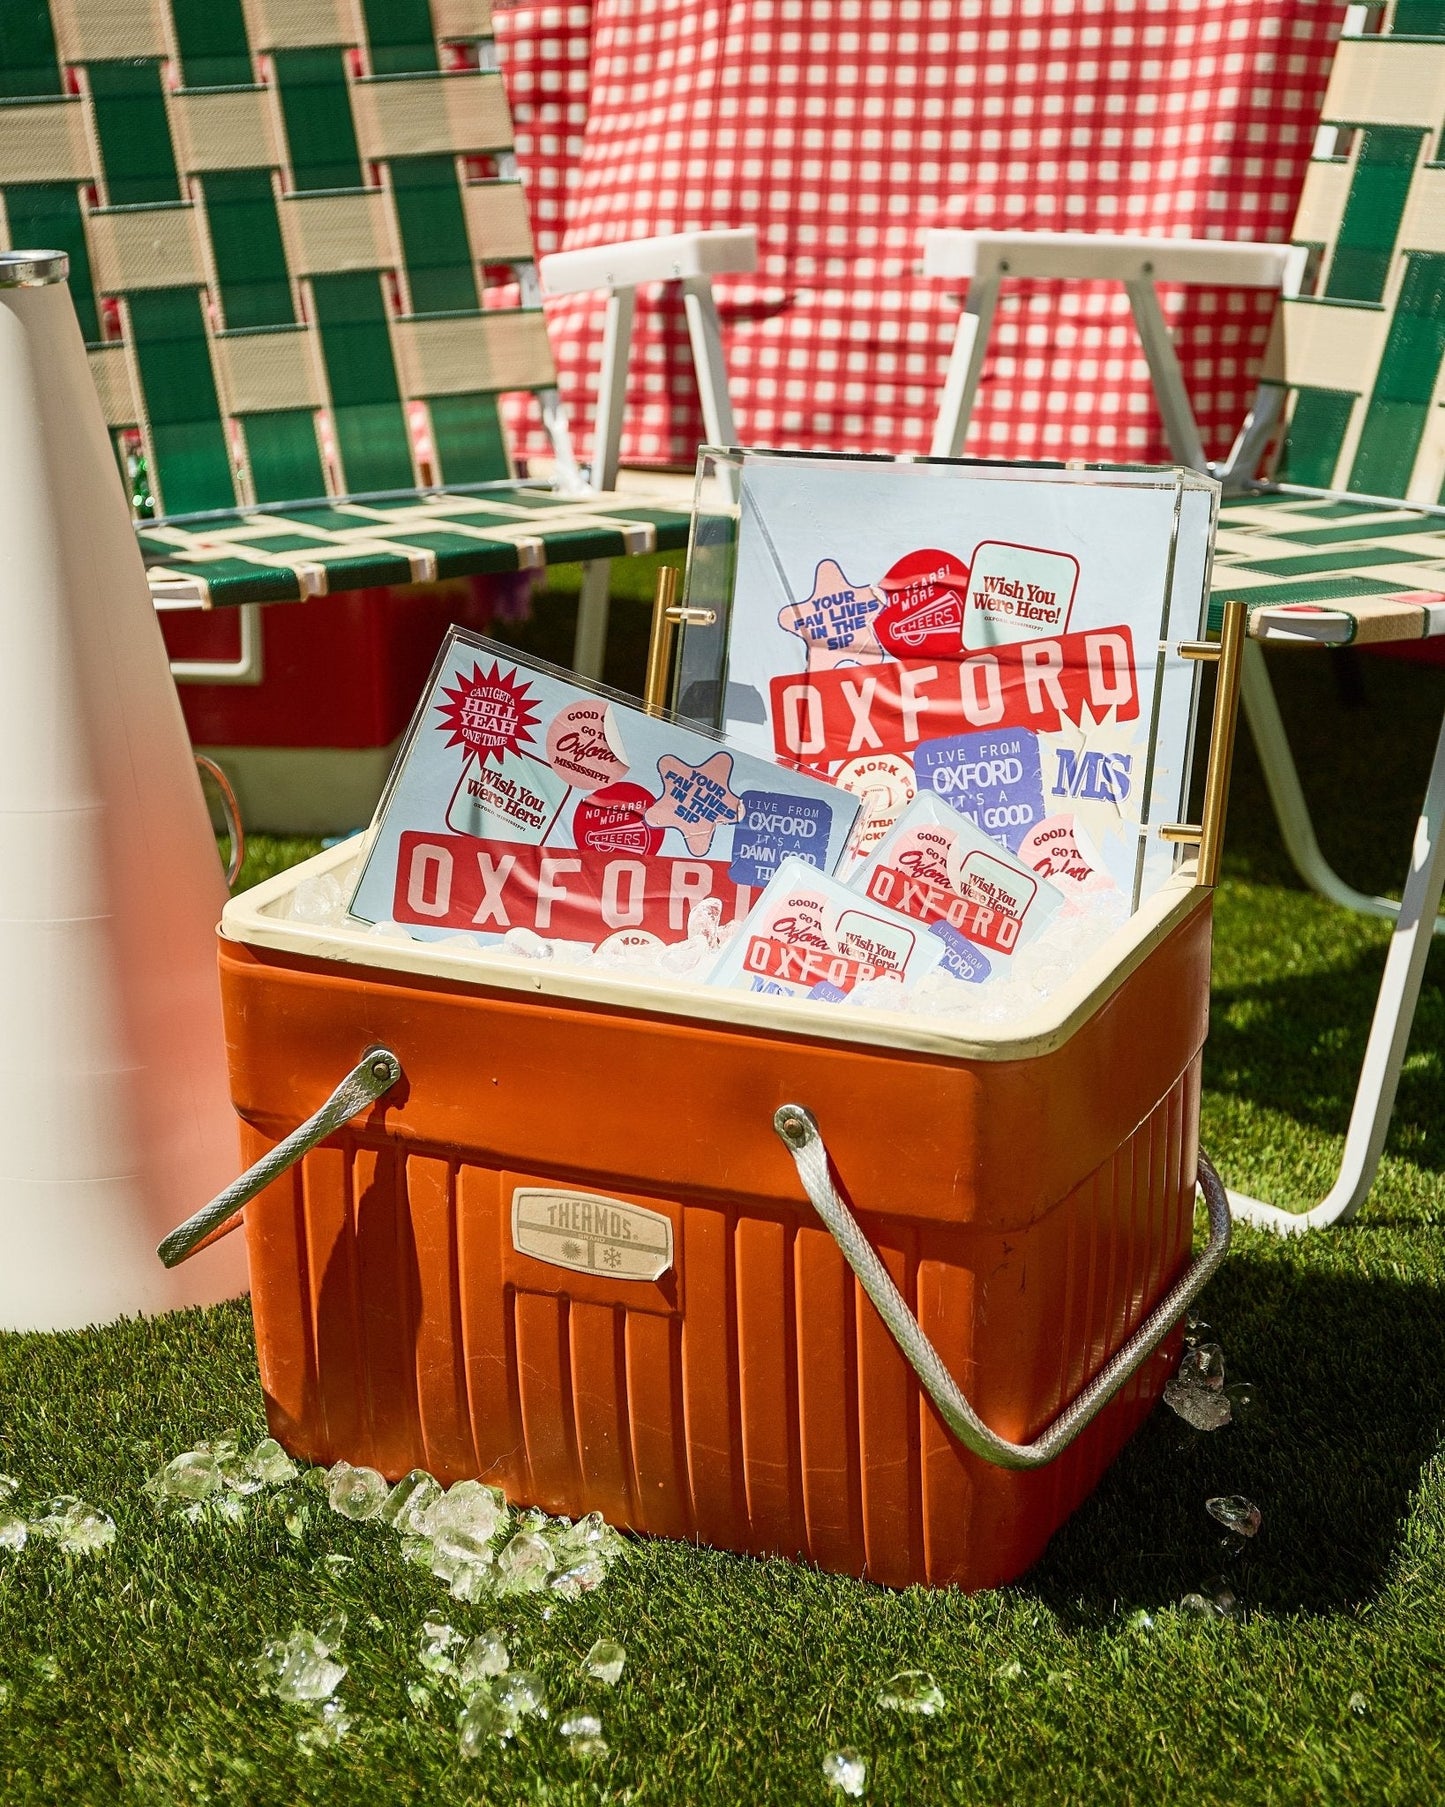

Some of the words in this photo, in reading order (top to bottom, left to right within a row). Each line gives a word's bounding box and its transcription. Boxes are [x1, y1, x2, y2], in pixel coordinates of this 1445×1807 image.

[905, 564, 950, 598] TEARS!
[983, 576, 1024, 599] Wish
[1027, 584, 1056, 605] You
[812, 590, 855, 612] YOUR
[902, 586, 935, 612] MORE
[972, 592, 1014, 614] Were
[1015, 600, 1061, 624] Here!
[794, 612, 824, 631] FAV
[829, 599, 879, 621] LIVES
[900, 608, 954, 633] CHEERS
[810, 625, 828, 640] IN
[832, 616, 866, 635] THE
[827, 633, 855, 651] SIP
[470, 687, 489, 697] CAN
[493, 688, 511, 703] GET
[509, 698, 515, 706] A
[782, 633, 1133, 754] OXFORD
[463, 697, 518, 722] HELL
[567, 711, 599, 721] GOOD
[460, 710, 518, 736] YEAH
[581, 726, 596, 737] GO
[462, 728, 481, 744] ONE
[481, 733, 507, 746] TIME
[926, 748, 966, 766] LIVE
[980, 741, 1021, 759] FROM
[553, 756, 610, 784] MISSISSIPPI
[932, 758, 1023, 794] OXFORD
[1051, 748, 1133, 804] MS
[480, 767, 517, 798] Wish
[517, 786, 545, 813] You
[664, 770, 694, 794] FAV
[694, 787, 738, 820] LIVES
[691, 770, 727, 799] YOUR
[854, 762, 899, 777] WORK
[900, 776, 915, 805] FO
[999, 790, 1008, 802] A
[467, 778, 504, 808] Were
[503, 798, 547, 829] Here!
[585, 809, 599, 819] NO
[606, 800, 647, 816] TEARS!
[670, 787, 687, 803] IN
[689, 800, 719, 823] THE
[674, 804, 701, 825] SIP
[748, 800, 778, 812] LIVE
[788, 805, 819, 818] FROM
[600, 812, 630, 825] MORE
[748, 811, 817, 838] OXFORD
[984, 804, 1033, 829] GOOD
[594, 833, 641, 846] CHEERS
[757, 834, 784, 847] IT'S
[794, 840, 801, 849] A
[917, 832, 946, 846] GOOD
[1033, 828, 1067, 846] GOOD
[740, 844, 776, 863] DAMN
[926, 847, 939, 860] GO
[1051, 848, 1068, 857] GO
[407, 843, 751, 930] OXFOR
[969, 873, 994, 897] Wish
[995, 887, 1017, 907] You
[788, 900, 818, 909] GOOD
[872, 870, 1020, 948] OXFORD
[960, 882, 986, 903] Were
[987, 896, 1019, 917] Here!
[799, 913, 813, 924] GO
[845, 932, 874, 953] Wish
[875, 942, 897, 960] You
[938, 926, 958, 948] LIVE
[961, 949, 983, 970] FROM
[867, 953, 899, 970] Here!
[547, 1202, 632, 1240] THERMOS
